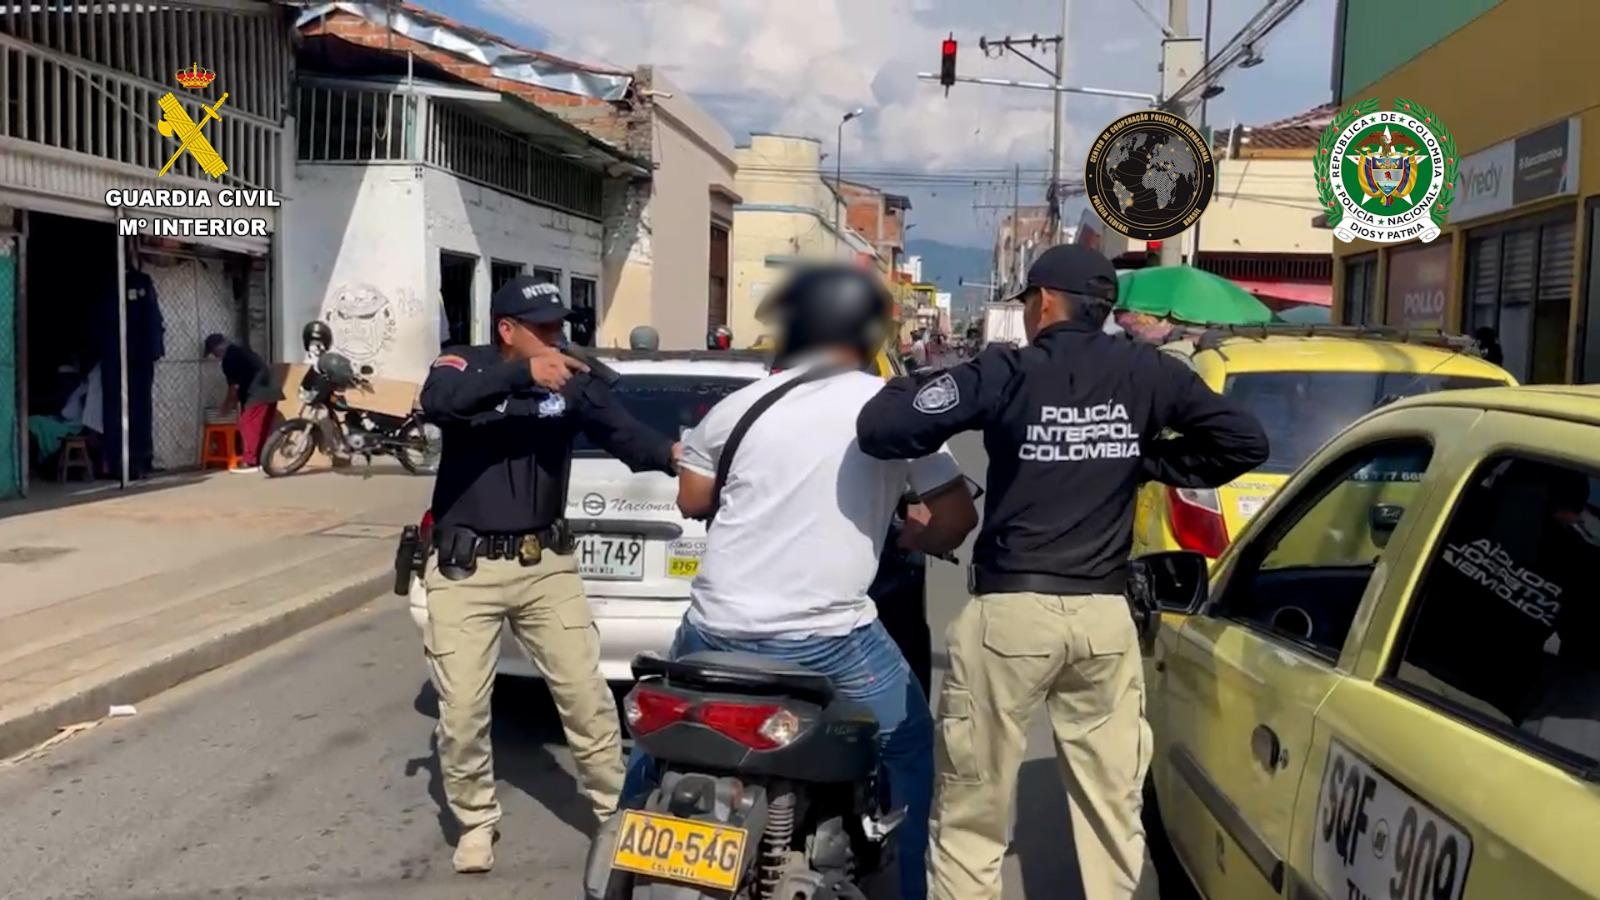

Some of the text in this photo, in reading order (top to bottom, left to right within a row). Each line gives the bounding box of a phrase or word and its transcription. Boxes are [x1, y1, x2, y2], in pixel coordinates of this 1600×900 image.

[1041, 399, 1129, 423] POLICÍA
[1026, 423, 1139, 442] INTERPOL
[1018, 442, 1140, 461] COLOMBIA
[609, 498, 677, 512] Nacional
[1323, 755, 1377, 867] SQF
